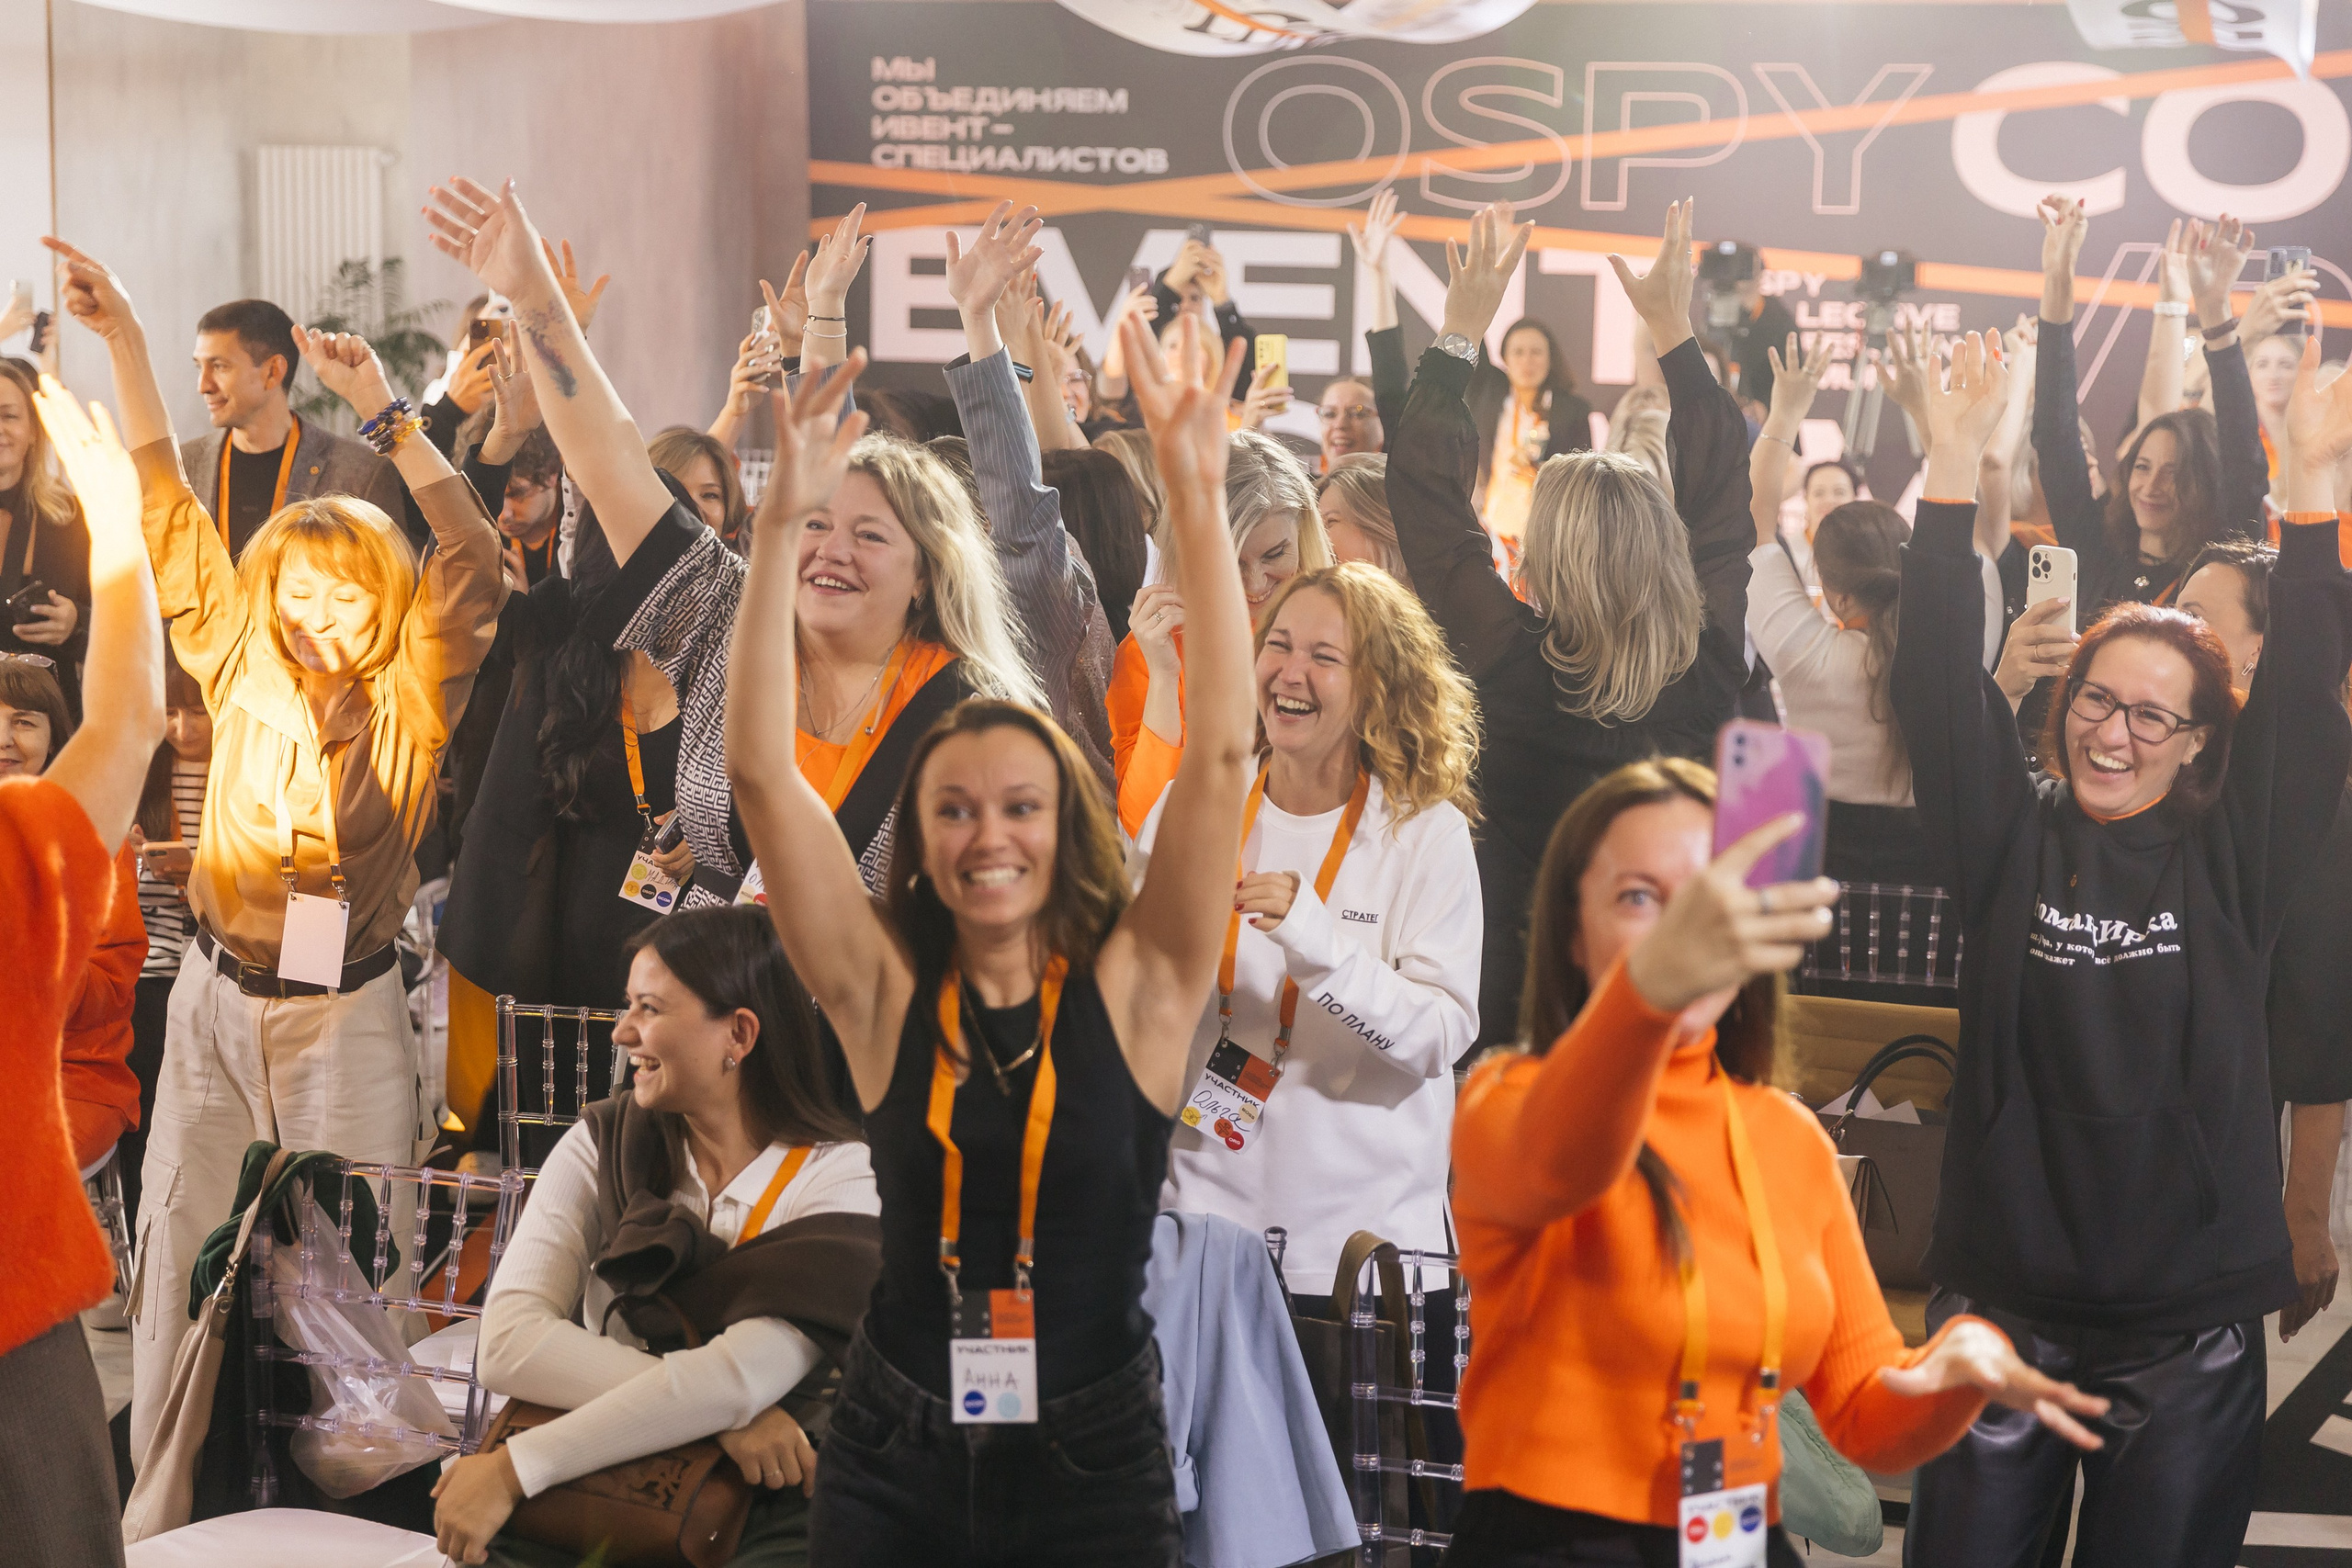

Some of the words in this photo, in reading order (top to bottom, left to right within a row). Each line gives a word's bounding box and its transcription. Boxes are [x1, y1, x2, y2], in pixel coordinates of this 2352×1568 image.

[871, 56, 935, 82] МЫ
[871, 85, 1128, 115] ОБЪЕДИНЯЕМ
[1223, 54, 1935, 215] OSPY
[871, 143, 1169, 174] СПЕЦИАЛИСТОВ
[2113, 947, 2154, 963] должно
[2156, 942, 2181, 953] быть
[1317, 992, 1344, 1015] ПО
[1341, 1014, 1395, 1050] ПЛАНУ
[1205, 1073, 1260, 1110] УЧАСТНИК
